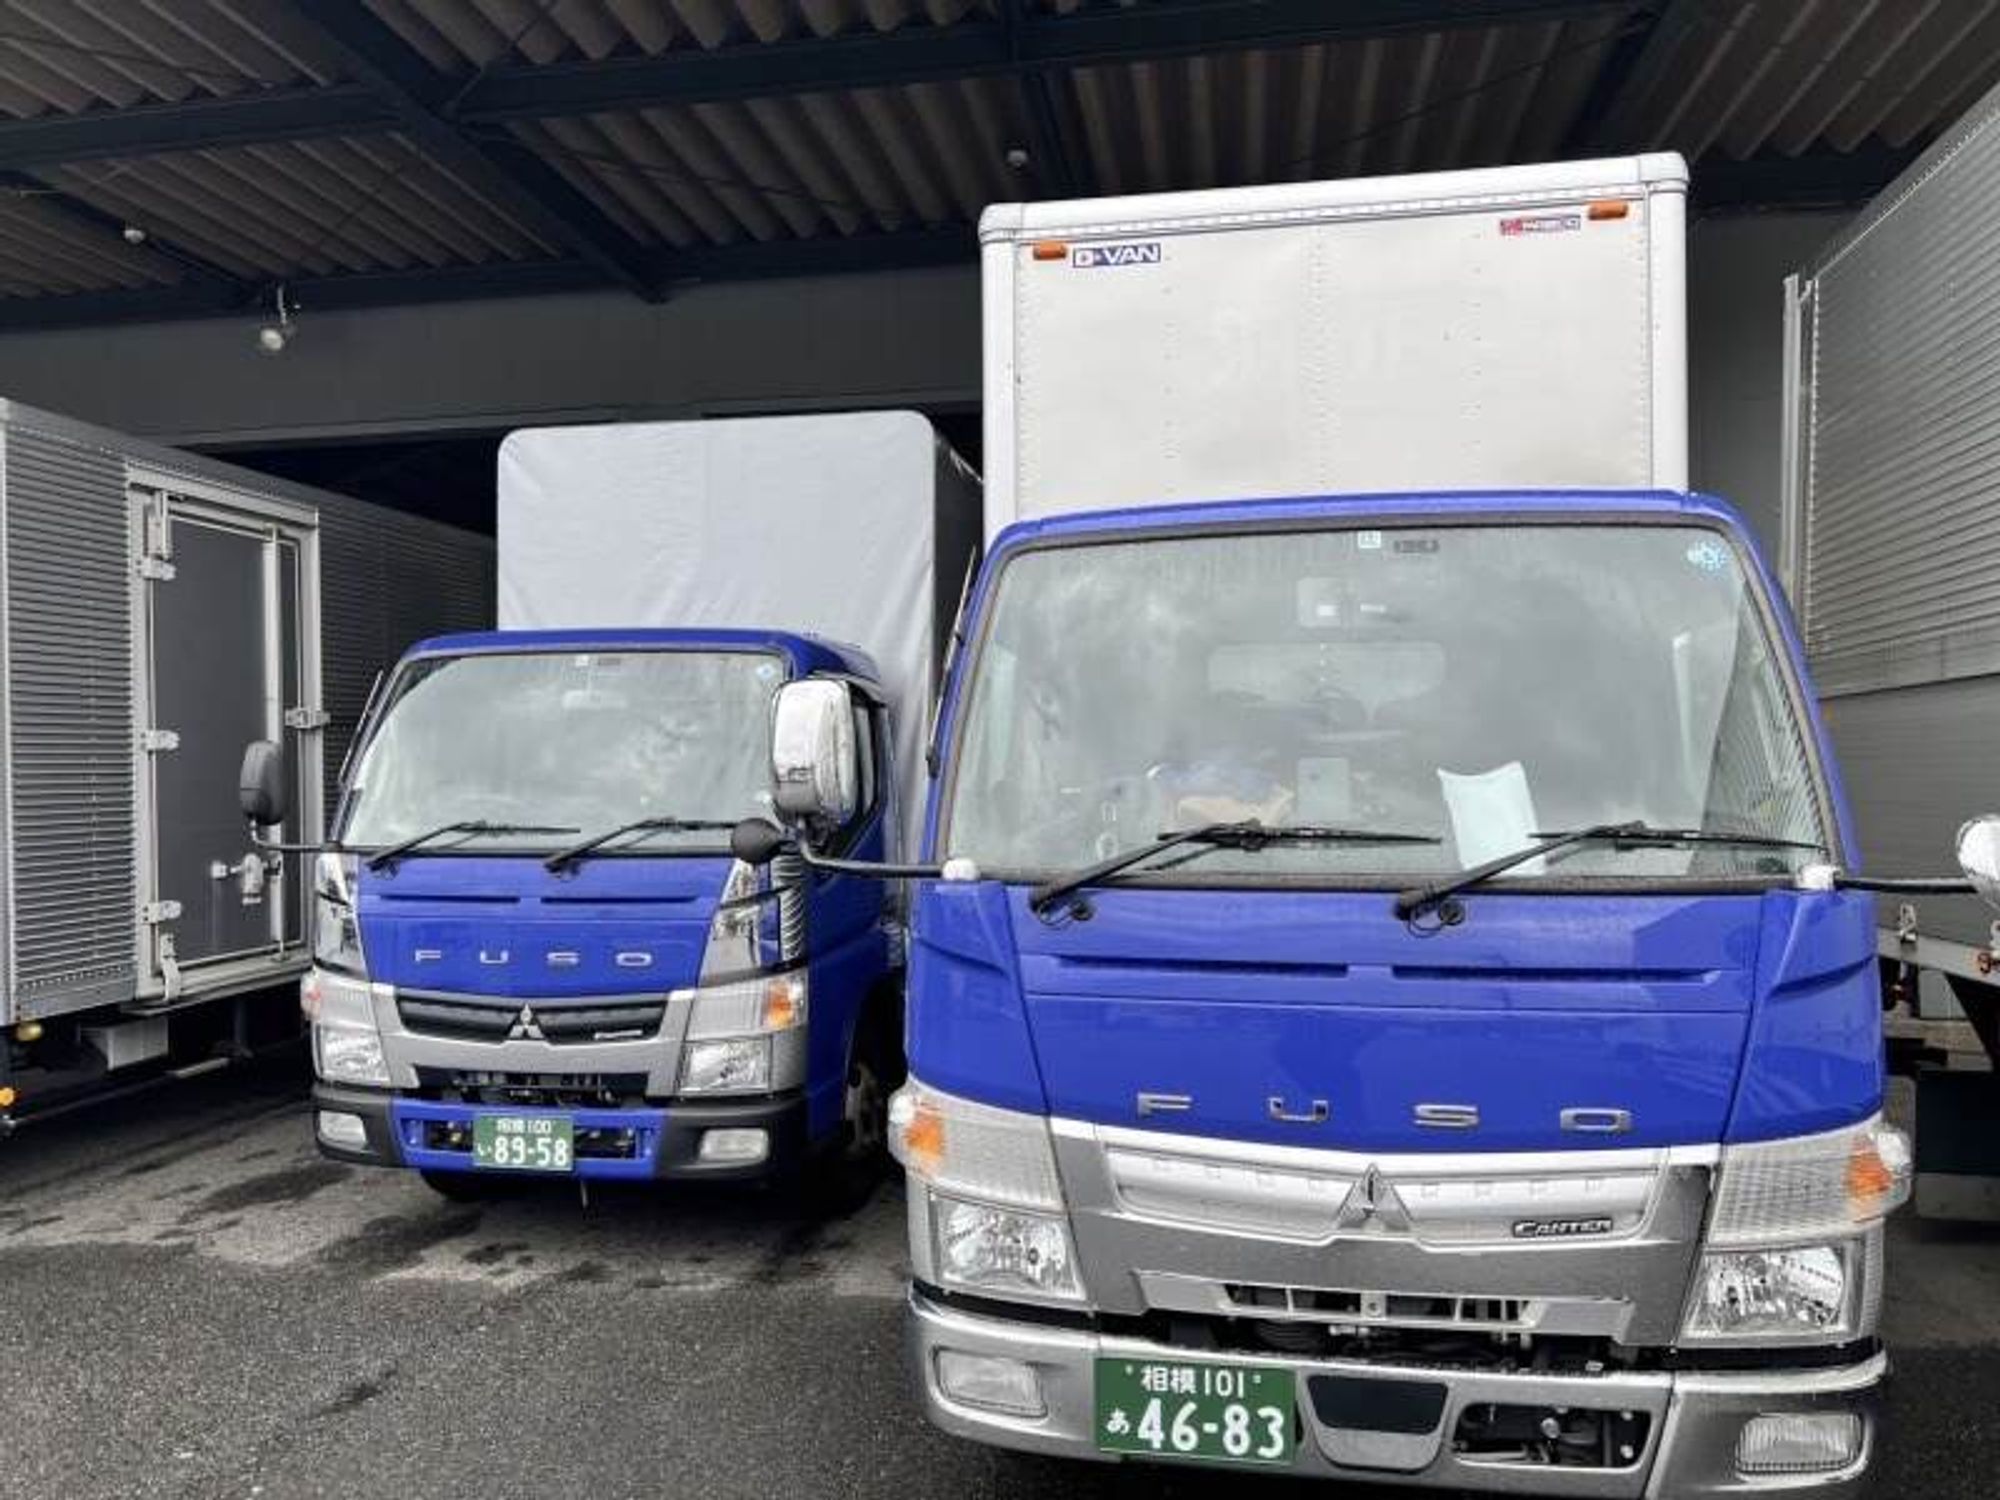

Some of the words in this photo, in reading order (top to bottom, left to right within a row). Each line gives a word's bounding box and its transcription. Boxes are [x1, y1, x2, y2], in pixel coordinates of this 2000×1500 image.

[414, 949, 653, 967] FUSO
[1137, 1092, 1632, 1132] FUSO
[495, 1135, 569, 1167] 89-58
[1106, 1408, 1130, 1435] あ
[1137, 1398, 1285, 1458] 46-83
